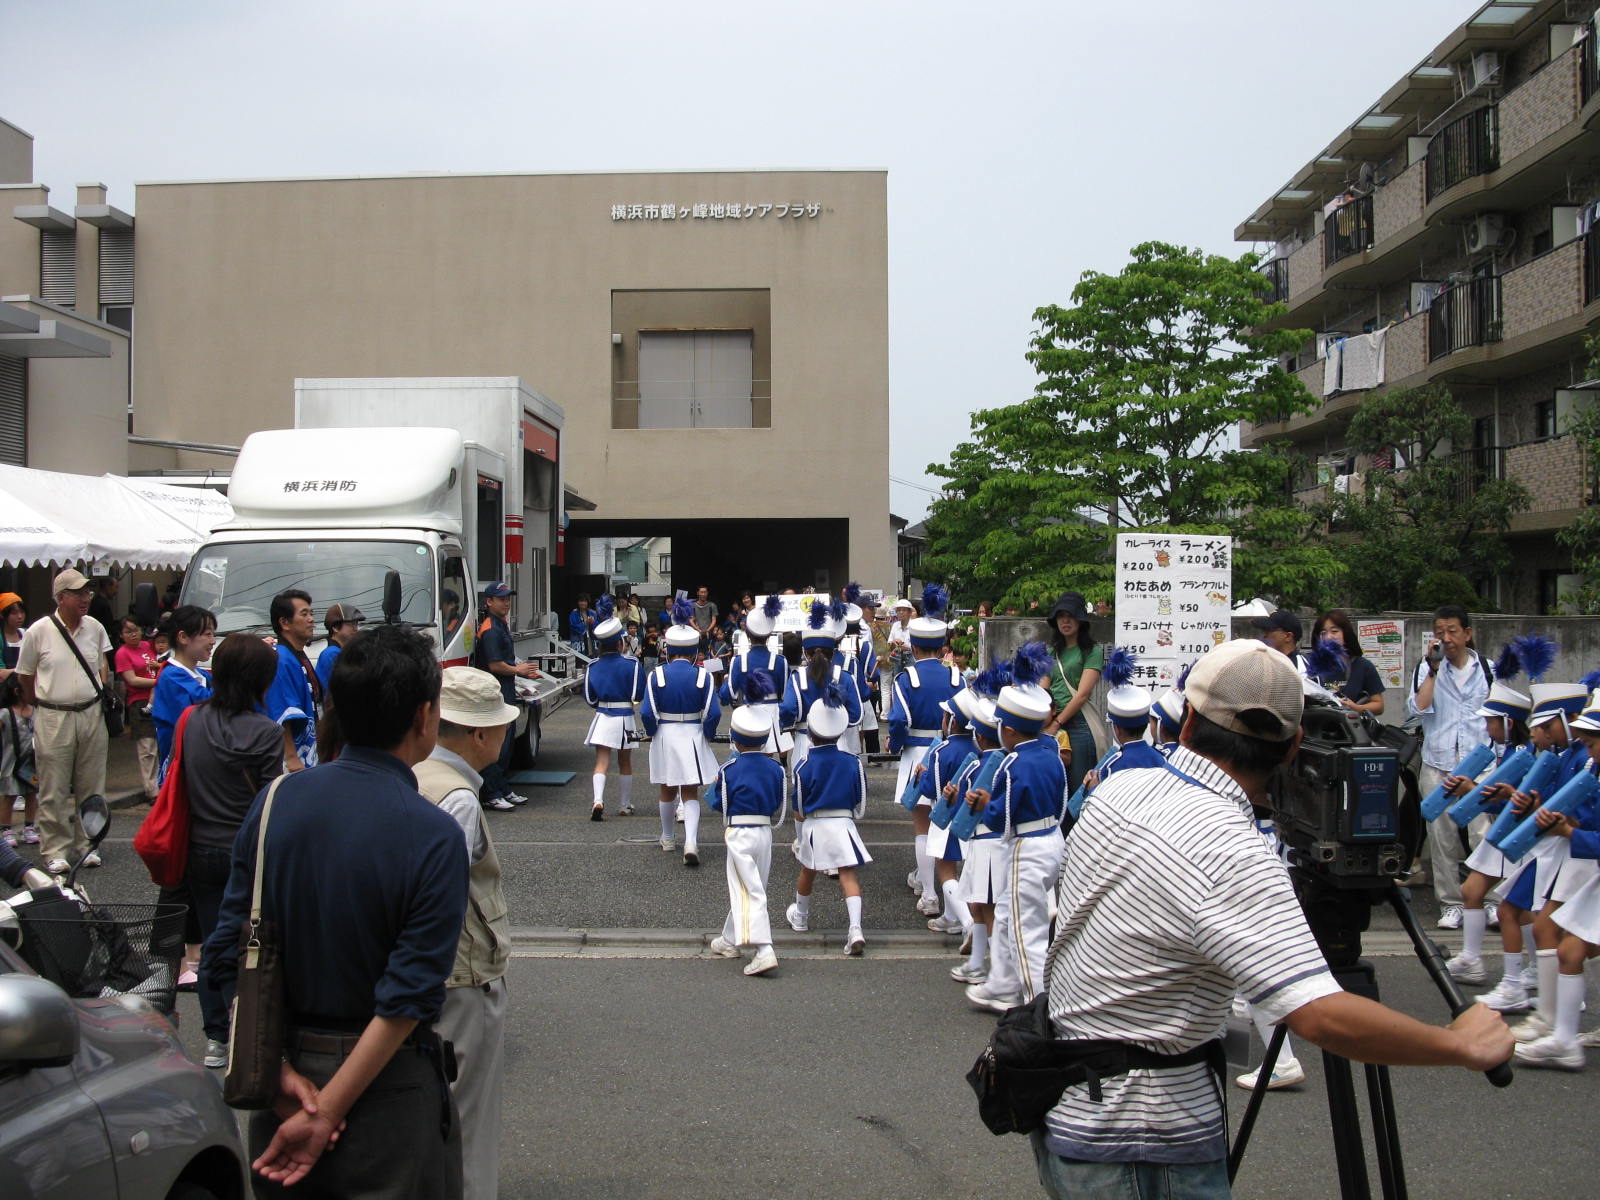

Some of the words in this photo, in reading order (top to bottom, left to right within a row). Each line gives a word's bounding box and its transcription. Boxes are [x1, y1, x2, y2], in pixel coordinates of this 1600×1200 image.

[611, 203, 821, 220] 横浜市鶴ヶ峰地域ケアプラザ
[283, 480, 358, 493] 横浜消防
[1125, 539, 1171, 548] カレーライス
[1180, 540, 1227, 551] ラーメン
[1179, 555, 1209, 564] ¥200
[1122, 562, 1153, 571] ¥200
[1124, 580, 1172, 592] わたあめ
[1180, 581, 1229, 590] フランクフルト
[1180, 603, 1199, 612] ¥50
[1122, 621, 1174, 631] チョコバナナ
[1180, 621, 1227, 630] じゃがバター
[1180, 644, 1210, 653] ¥100
[1134, 666, 1158, 678] 手芸
